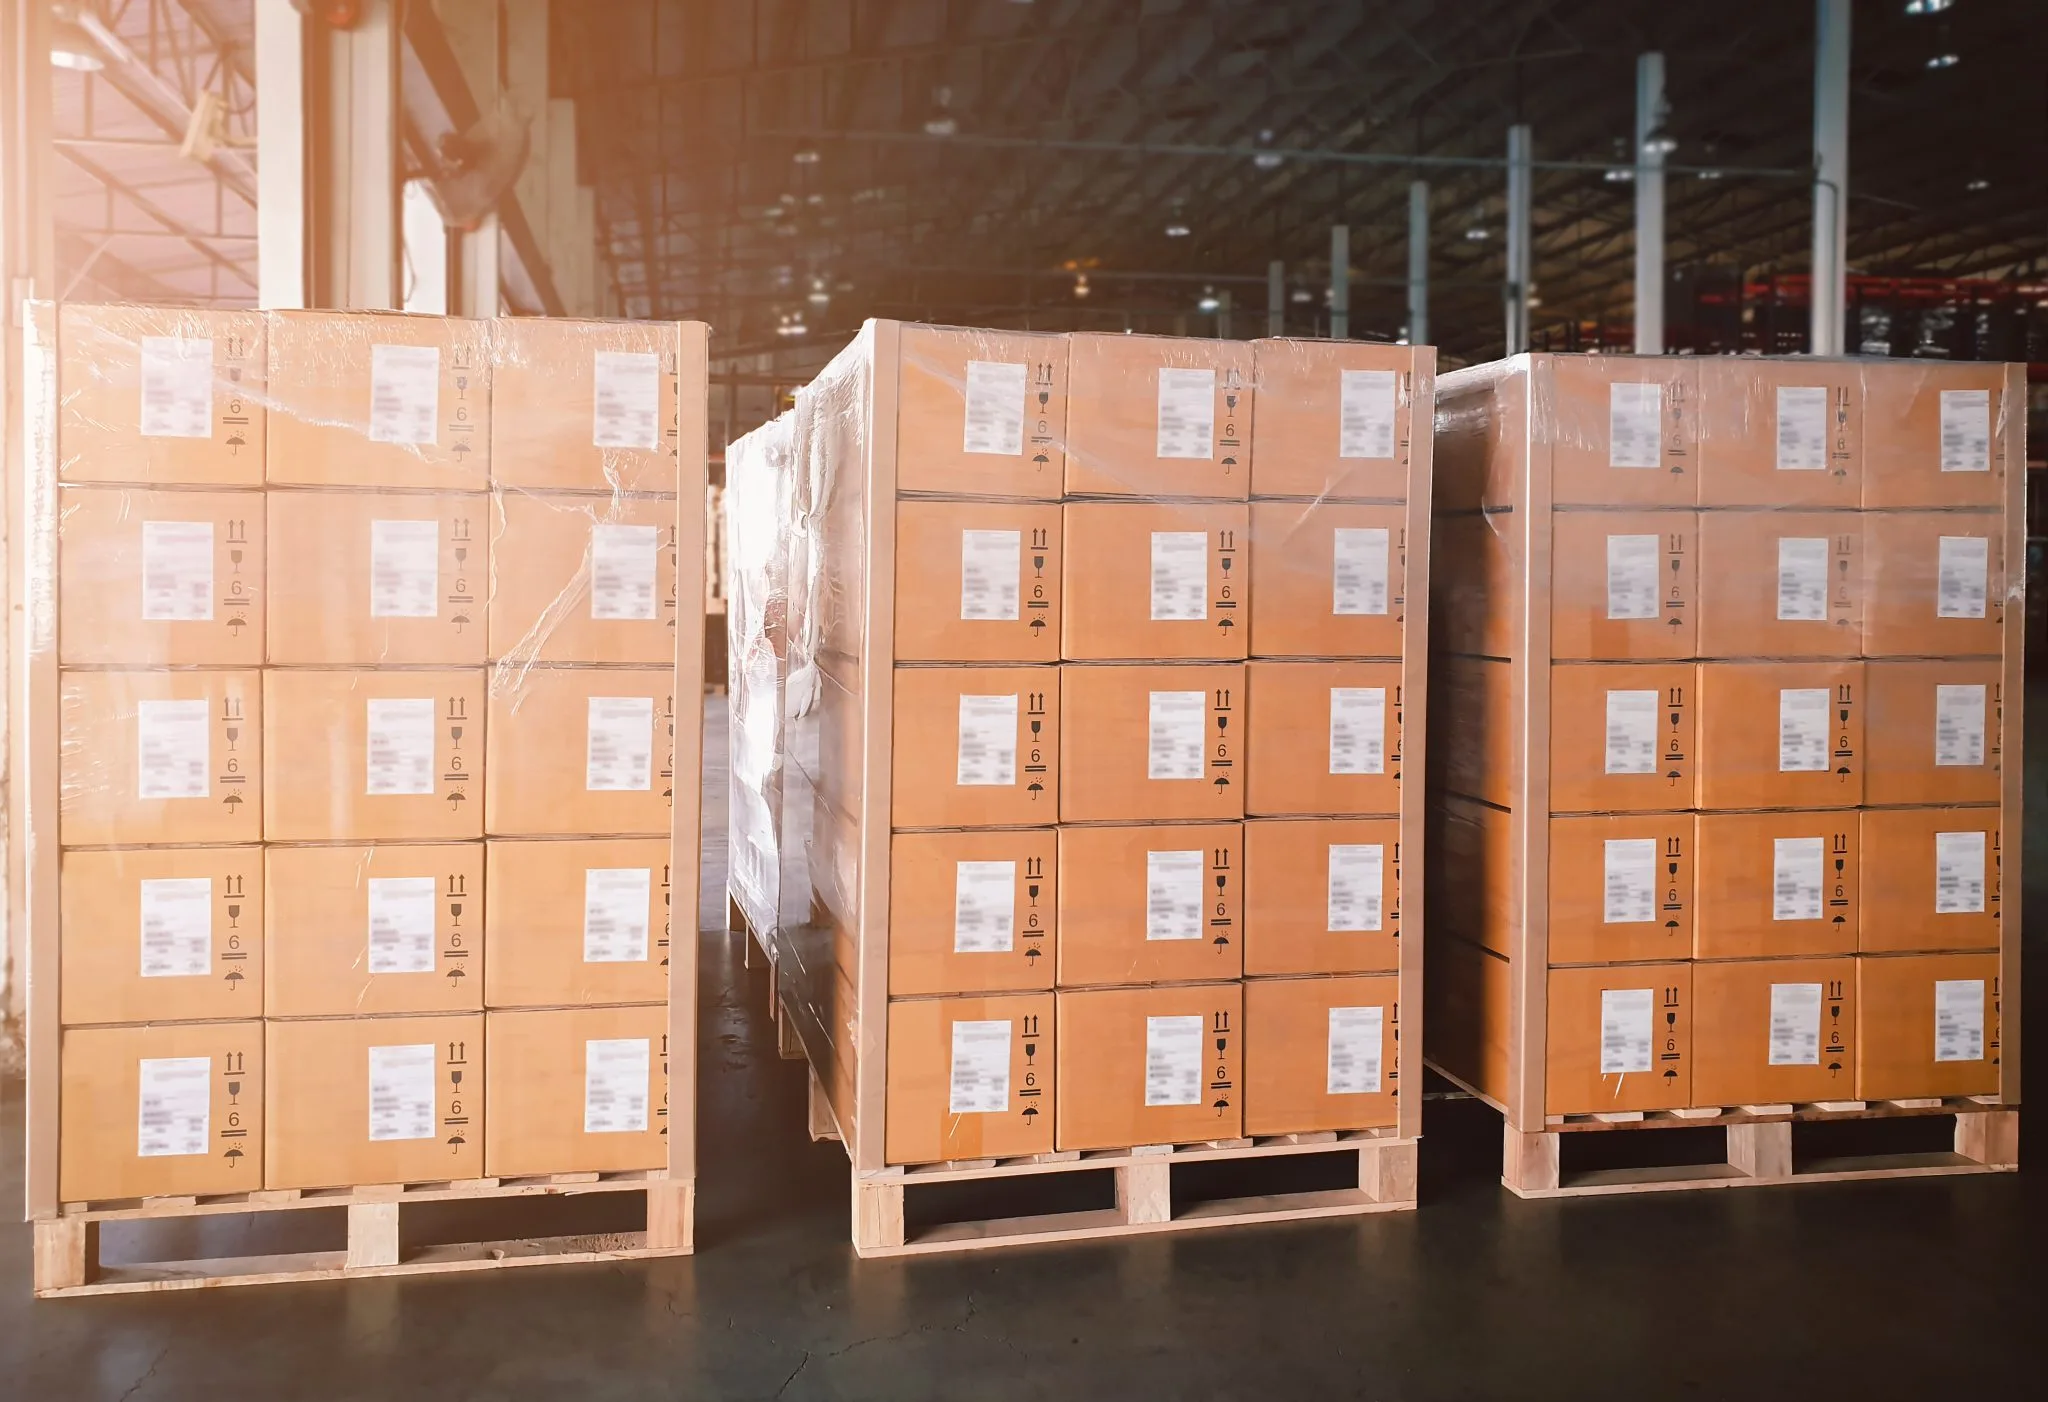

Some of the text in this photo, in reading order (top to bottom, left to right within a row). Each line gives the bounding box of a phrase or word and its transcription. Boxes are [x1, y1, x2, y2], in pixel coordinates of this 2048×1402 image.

[230, 399, 241, 413] 6
[457, 407, 467, 421] 6
[1038, 420, 1047, 433] 6
[1226, 424, 1234, 436] 6
[231, 581, 242, 595] 6
[456, 578, 466, 592] 6
[1034, 585, 1043, 598] 6
[1222, 586, 1230, 599] 6
[1672, 586, 1679, 598] 6
[1671, 739, 1678, 751] 6
[1840, 736, 1848, 748] 6
[1031, 749, 1040, 762] 6
[1218, 744, 1226, 757] 6
[227, 758, 238, 772] 6
[451, 757, 462, 770] 6
[1669, 889, 1677, 901] 6
[1835, 885, 1843, 897] 6
[1216, 903, 1225, 916] 6
[1029, 914, 1038, 927] 6
[229, 935, 239, 950] 6
[451, 933, 461, 947] 6
[1831, 1031, 1839, 1044] 6
[1667, 1039, 1675, 1051] 6
[1217, 1066, 1226, 1079] 6
[1026, 1073, 1035, 1086] 6
[452, 1100, 462, 1114] 6
[229, 1112, 240, 1126] 6
